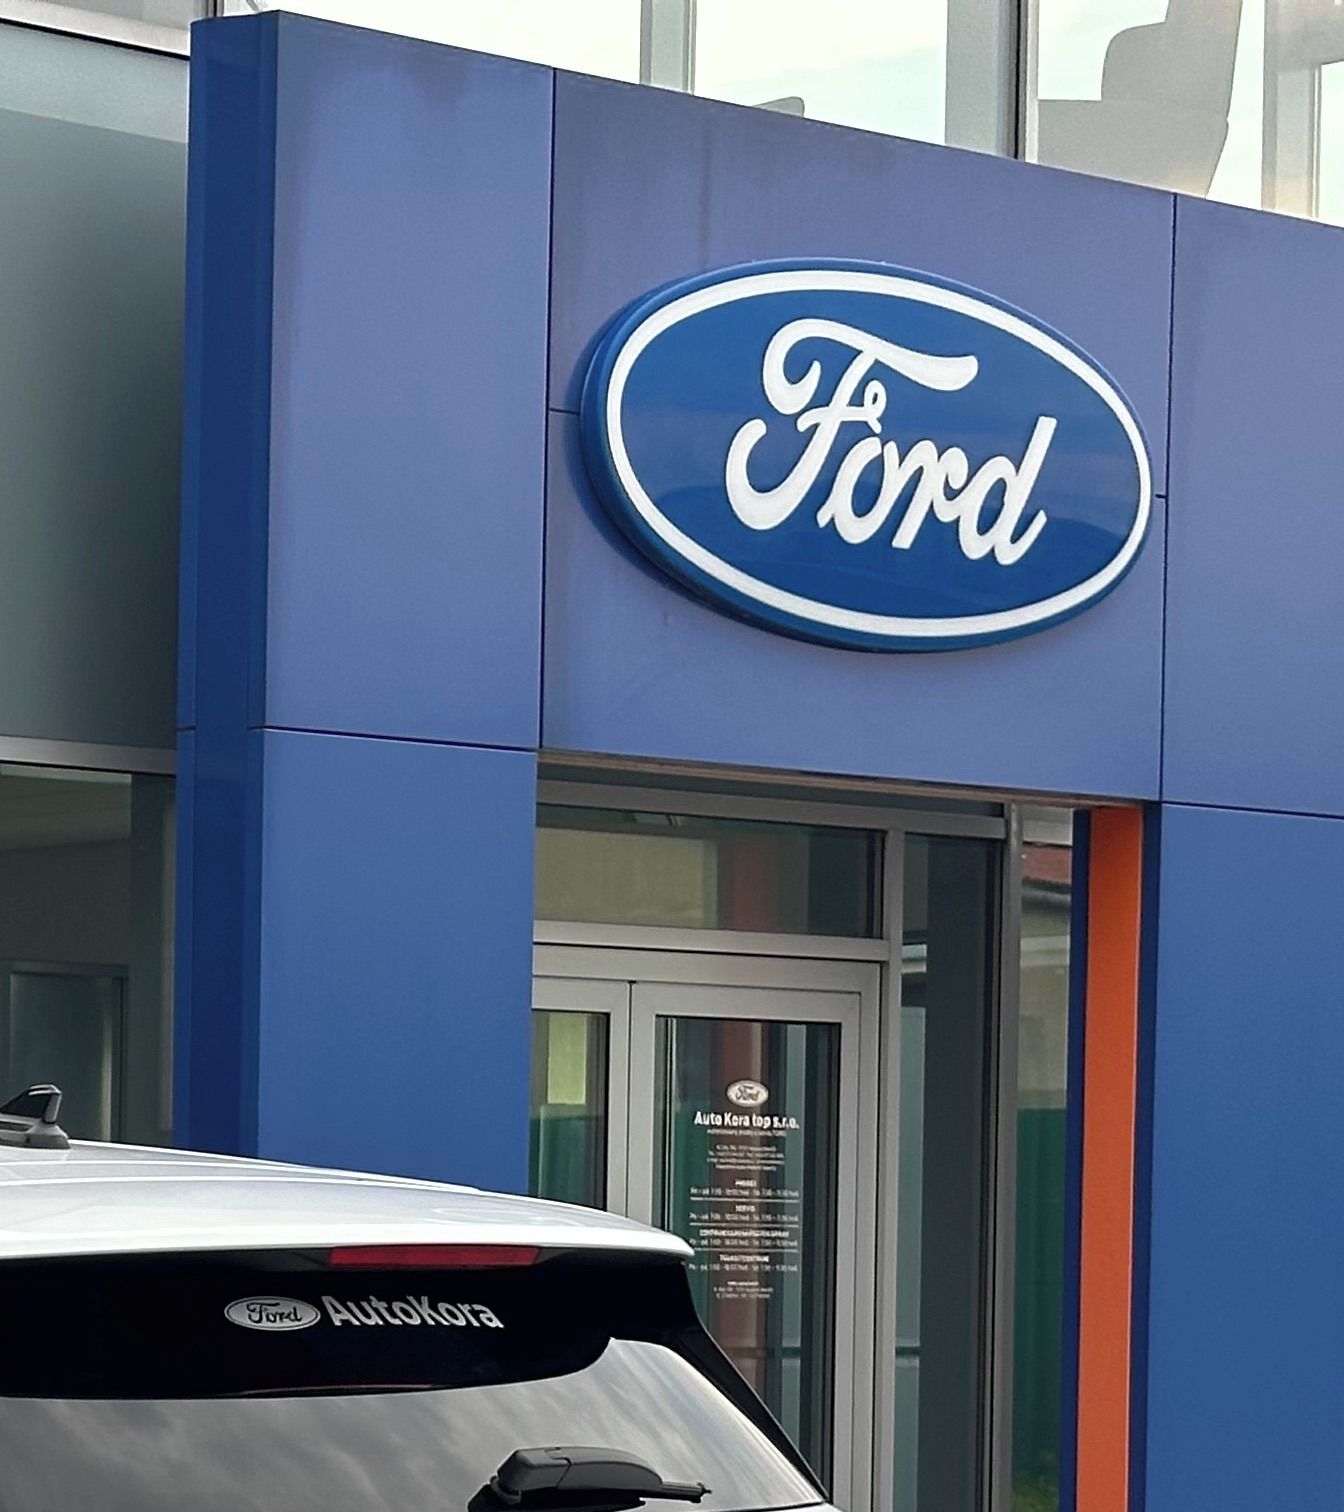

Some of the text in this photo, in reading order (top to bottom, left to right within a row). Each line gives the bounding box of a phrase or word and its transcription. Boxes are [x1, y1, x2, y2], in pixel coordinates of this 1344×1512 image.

[726, 318, 1057, 565] Ford
[694, 1111, 800, 1129] Auto Kora top s.r.o.
[246, 1295, 505, 1328] Ford AutoKora
